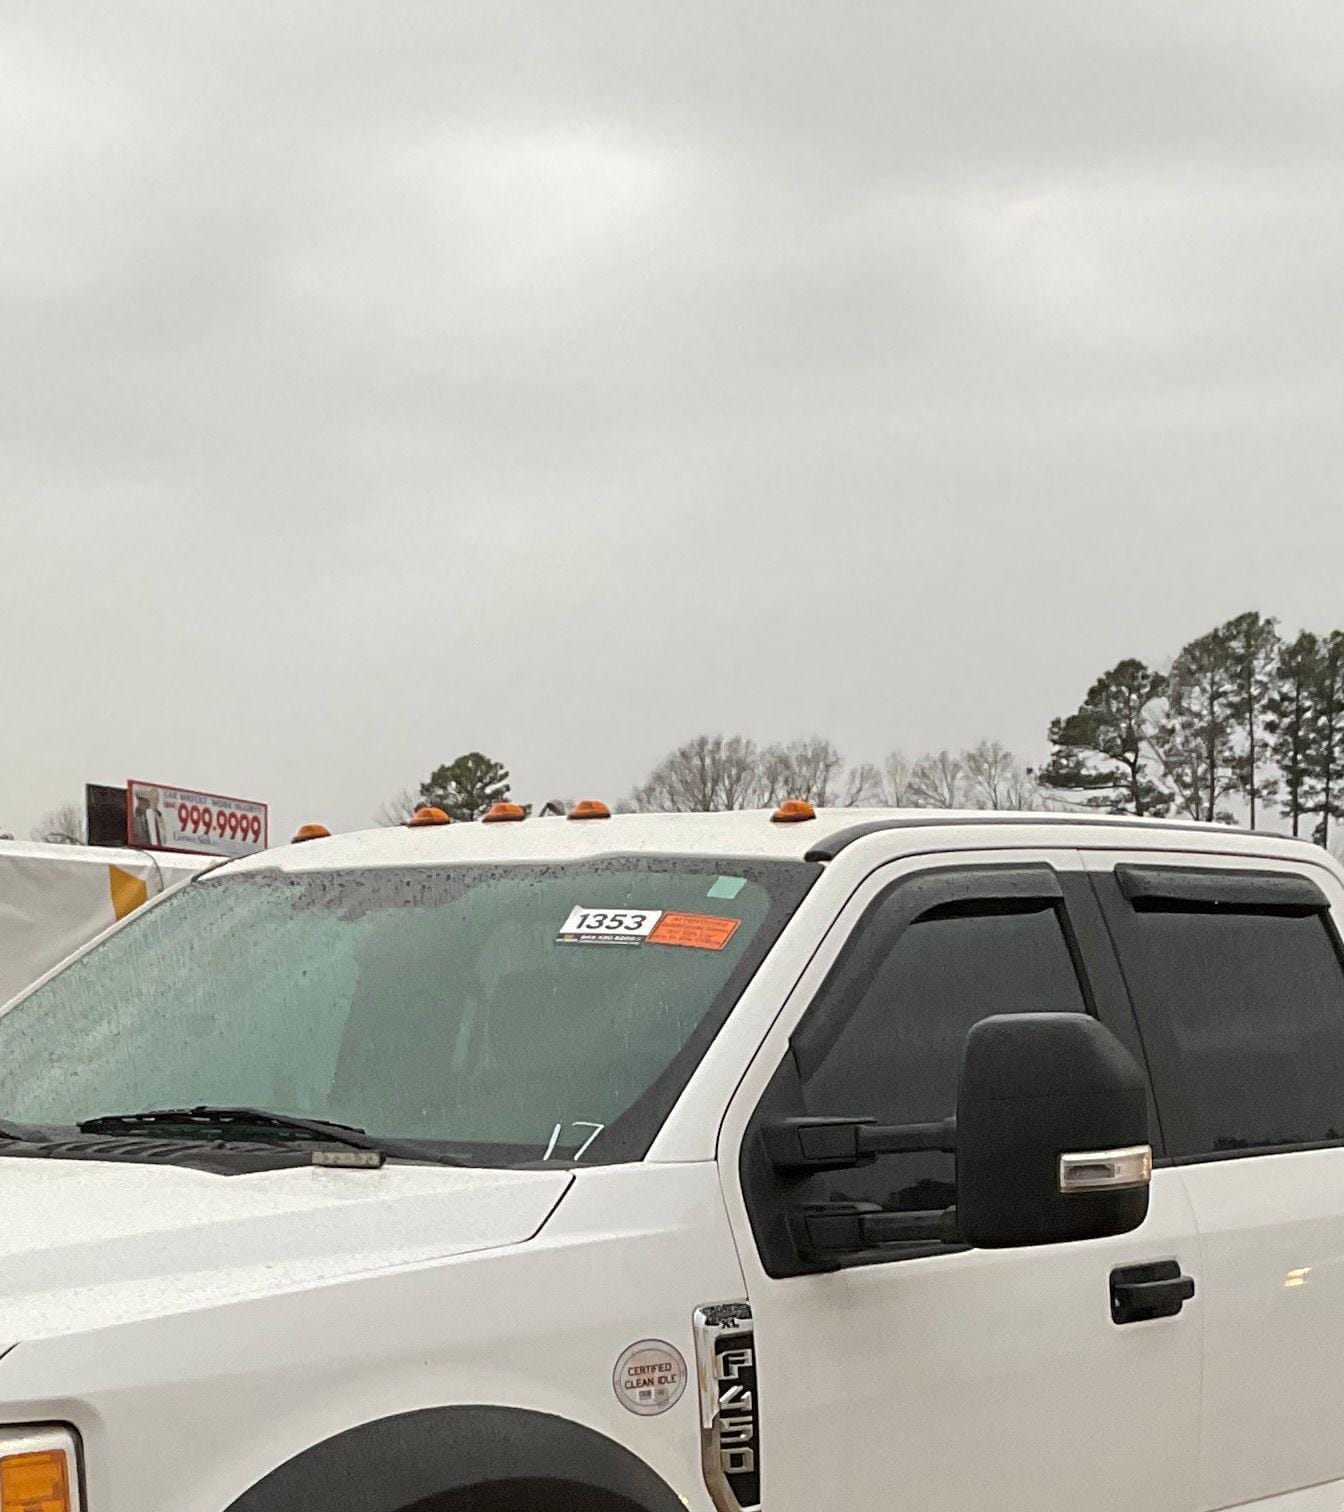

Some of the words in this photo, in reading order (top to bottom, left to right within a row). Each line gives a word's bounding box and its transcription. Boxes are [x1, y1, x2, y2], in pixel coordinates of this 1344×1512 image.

[576, 913, 647, 931] 1353
[627, 1362, 672, 1377] CERTIFIED
[624, 1377, 655, 1390] CLEAN
[657, 1373, 678, 1386] IDLE
